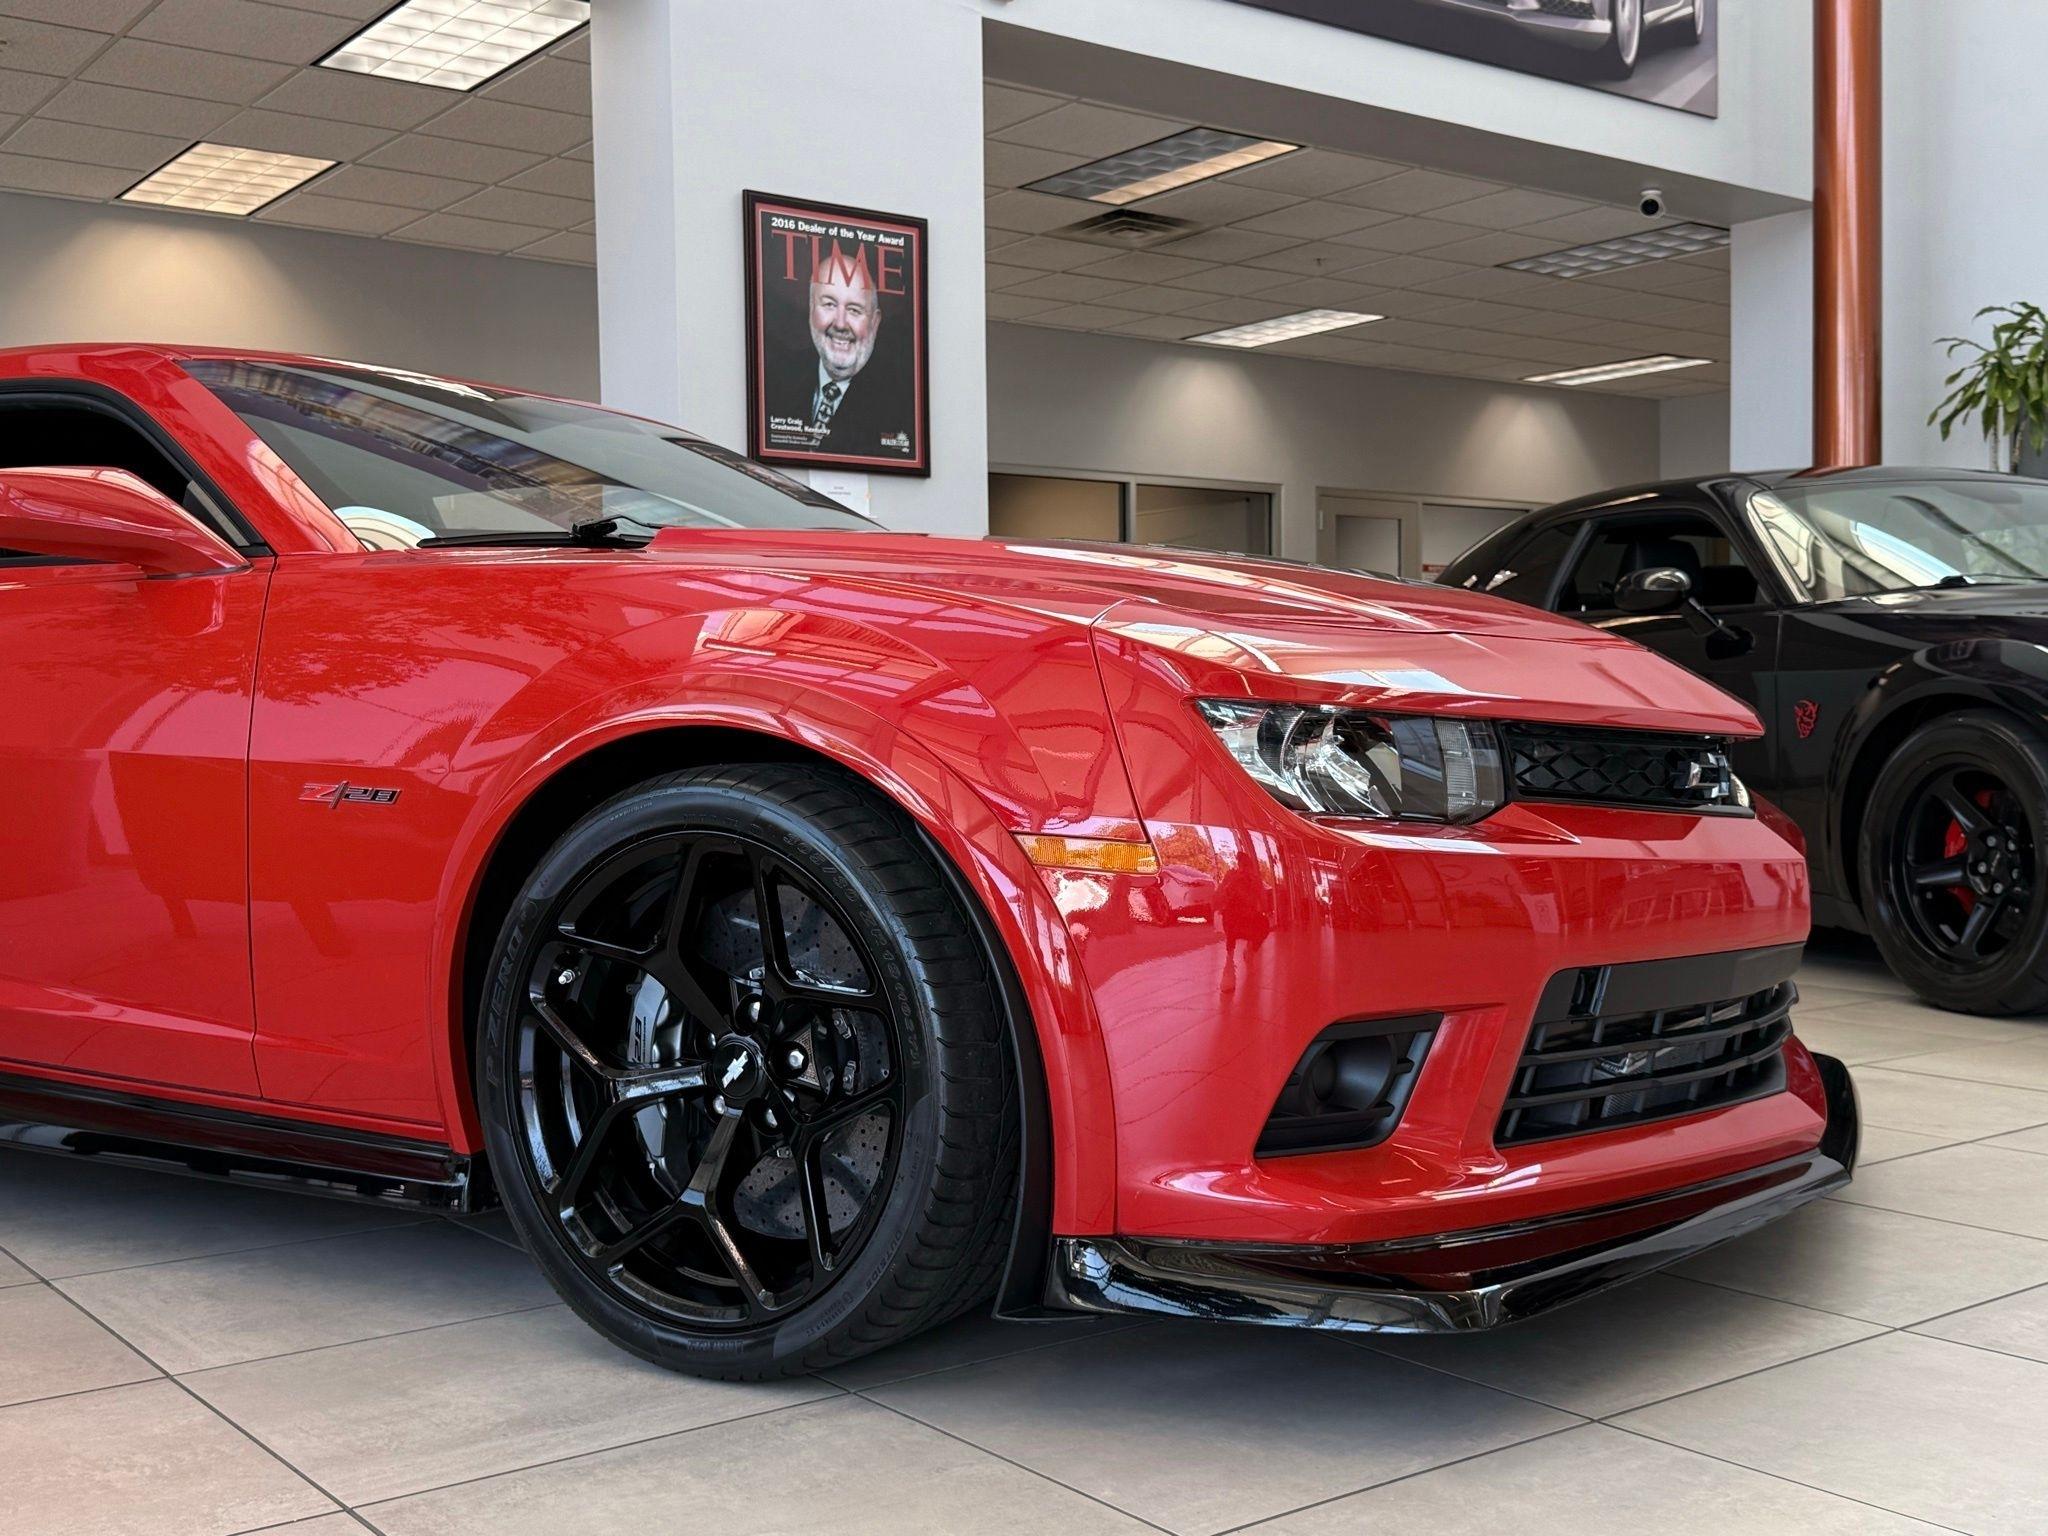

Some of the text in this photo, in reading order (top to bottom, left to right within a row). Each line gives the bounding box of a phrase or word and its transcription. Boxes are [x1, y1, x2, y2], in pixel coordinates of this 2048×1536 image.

[771, 217, 905, 247] 2016 Dealer of the Year Award
[771, 229, 905, 295] TIME
[770, 415, 786, 425] Larry
[487, 925, 524, 1048] ZERO
